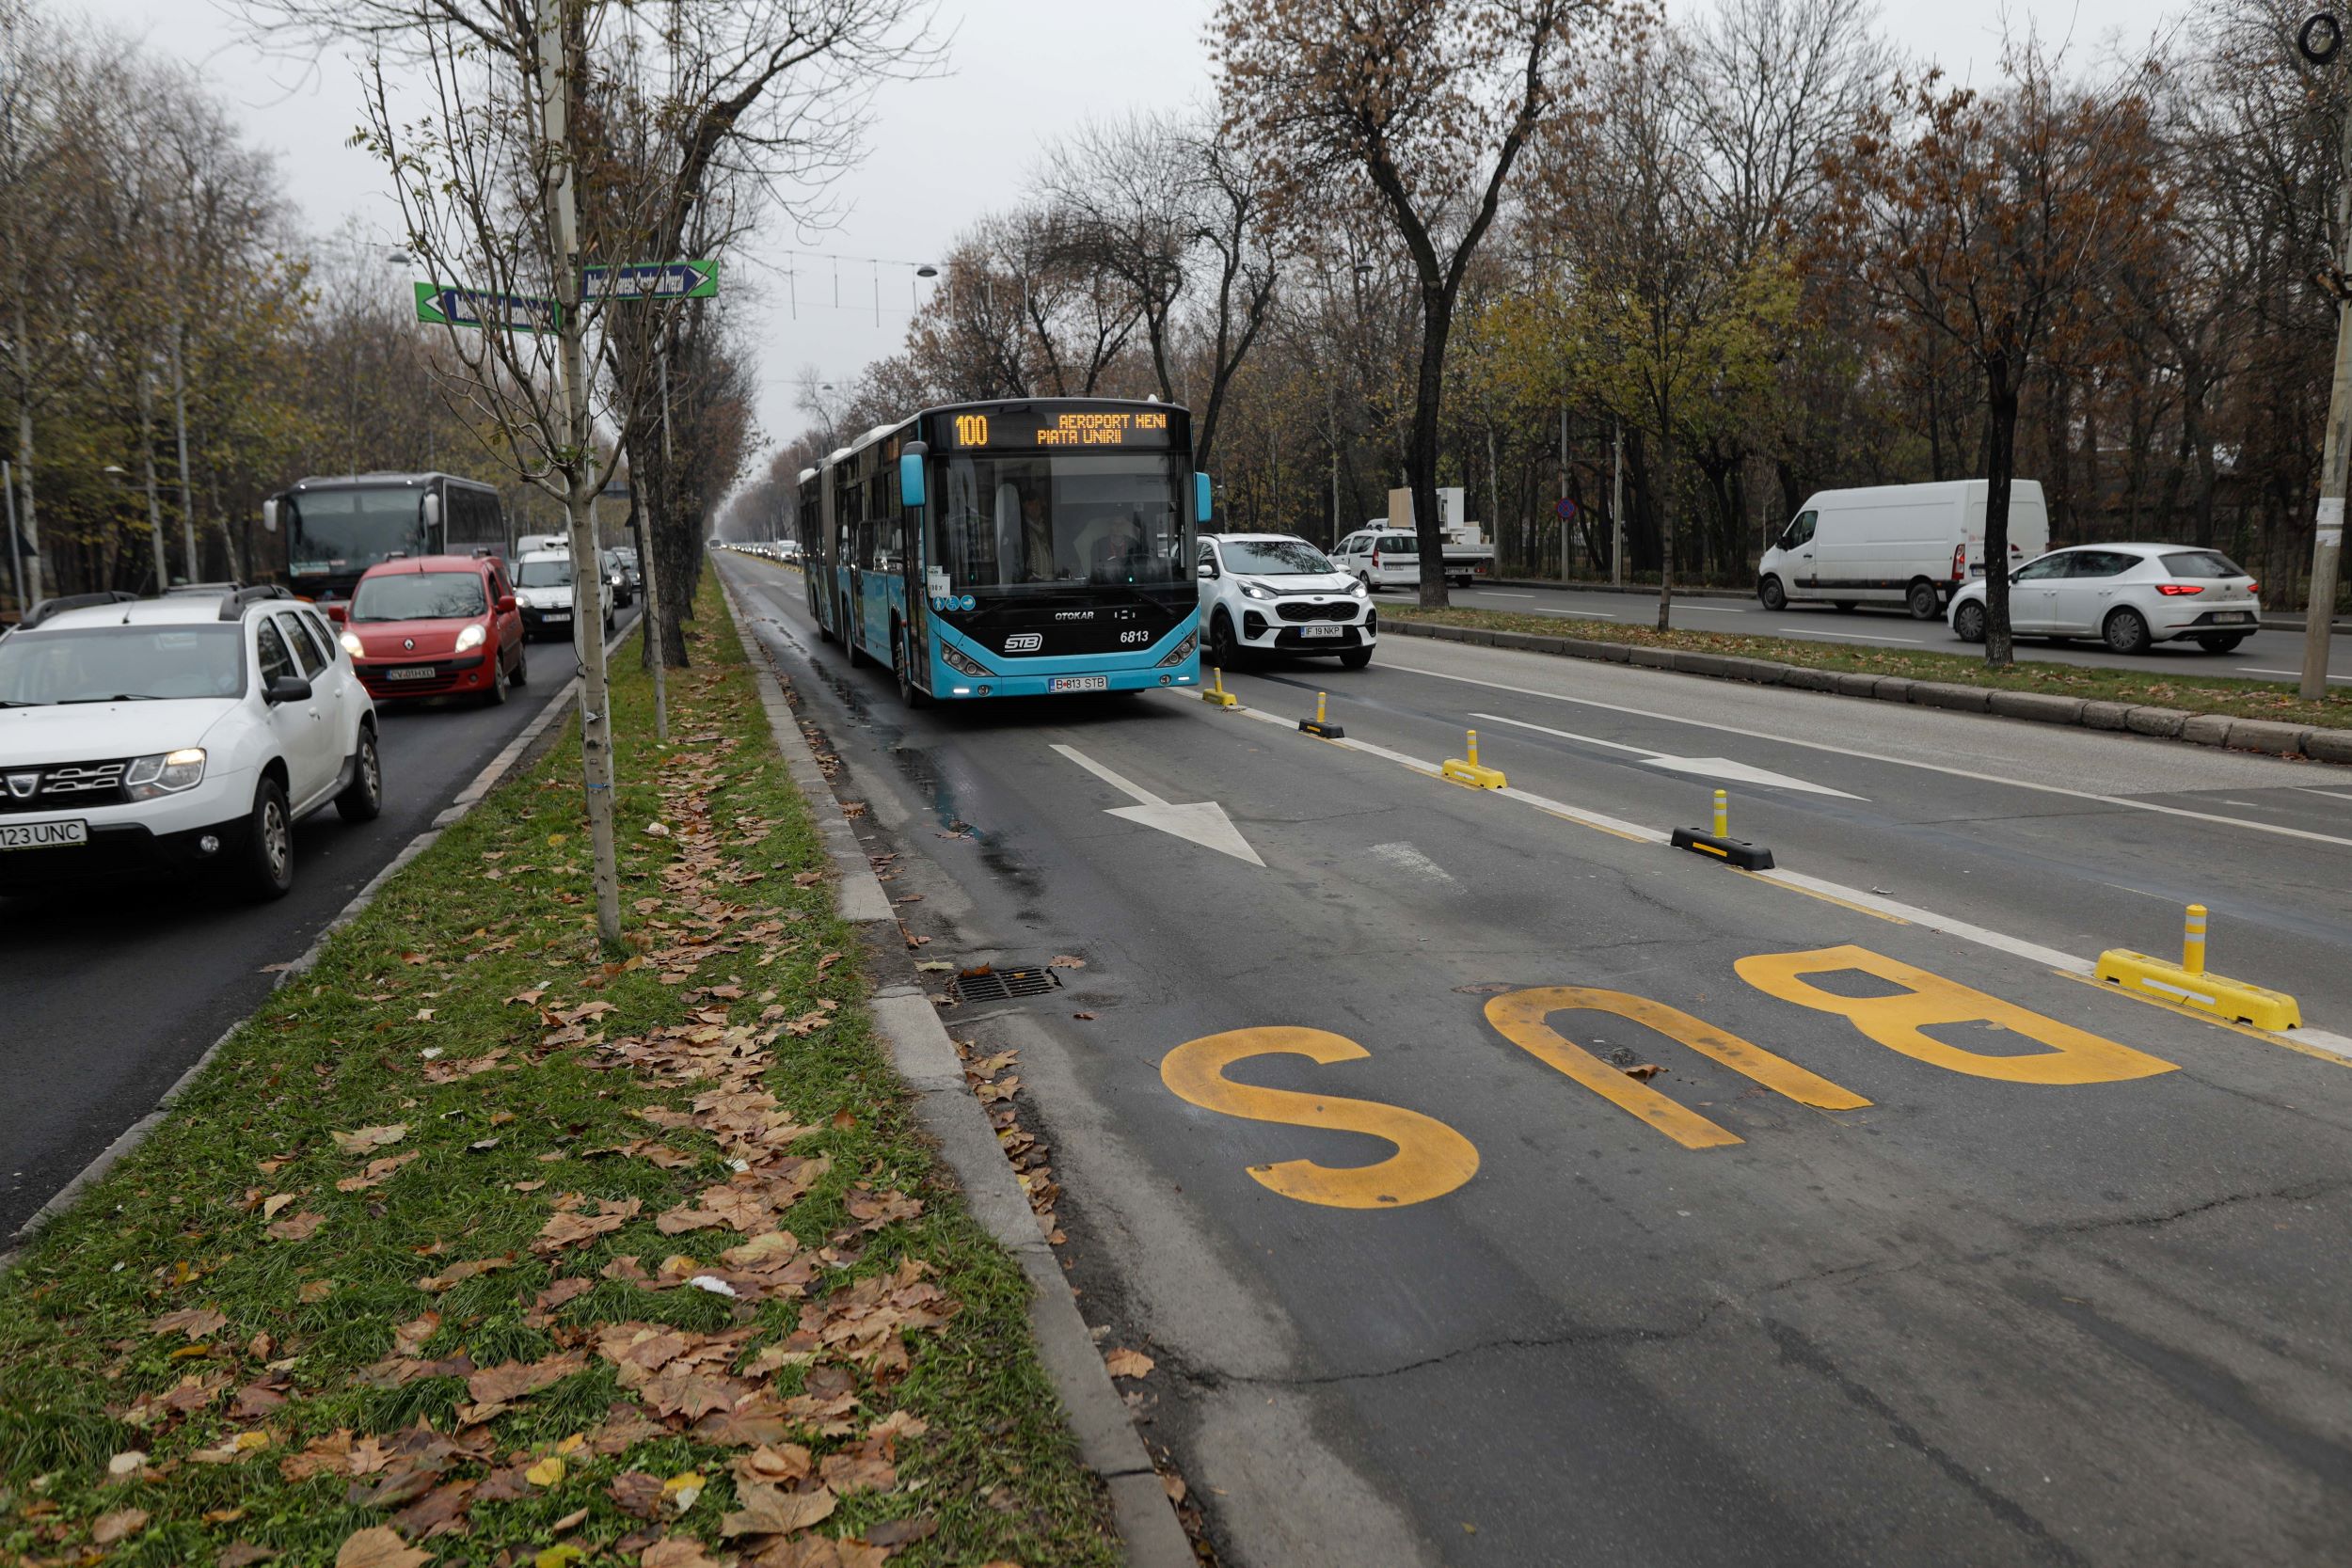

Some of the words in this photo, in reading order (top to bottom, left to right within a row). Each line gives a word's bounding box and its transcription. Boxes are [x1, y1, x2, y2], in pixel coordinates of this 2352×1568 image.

[1059, 414, 1130, 429] AEROPORT
[1136, 414, 1167, 429] HENI
[956, 415, 988, 446] 100
[1038, 430, 1078, 444] PIATA
[1083, 429, 1122, 444] UNIRII
[1055, 611, 1094, 621] OTOKAR
[1120, 631, 1149, 642] 6813
[1324, 626, 1339, 635] NKP
[1005, 637, 1040, 649] STB
[1056, 680, 1063, 689] B
[1067, 679, 1081, 689] 813
[1085, 678, 1104, 688] STB
[34, 824, 80, 843] UNC
[1161, 944, 2182, 1209] BUS
